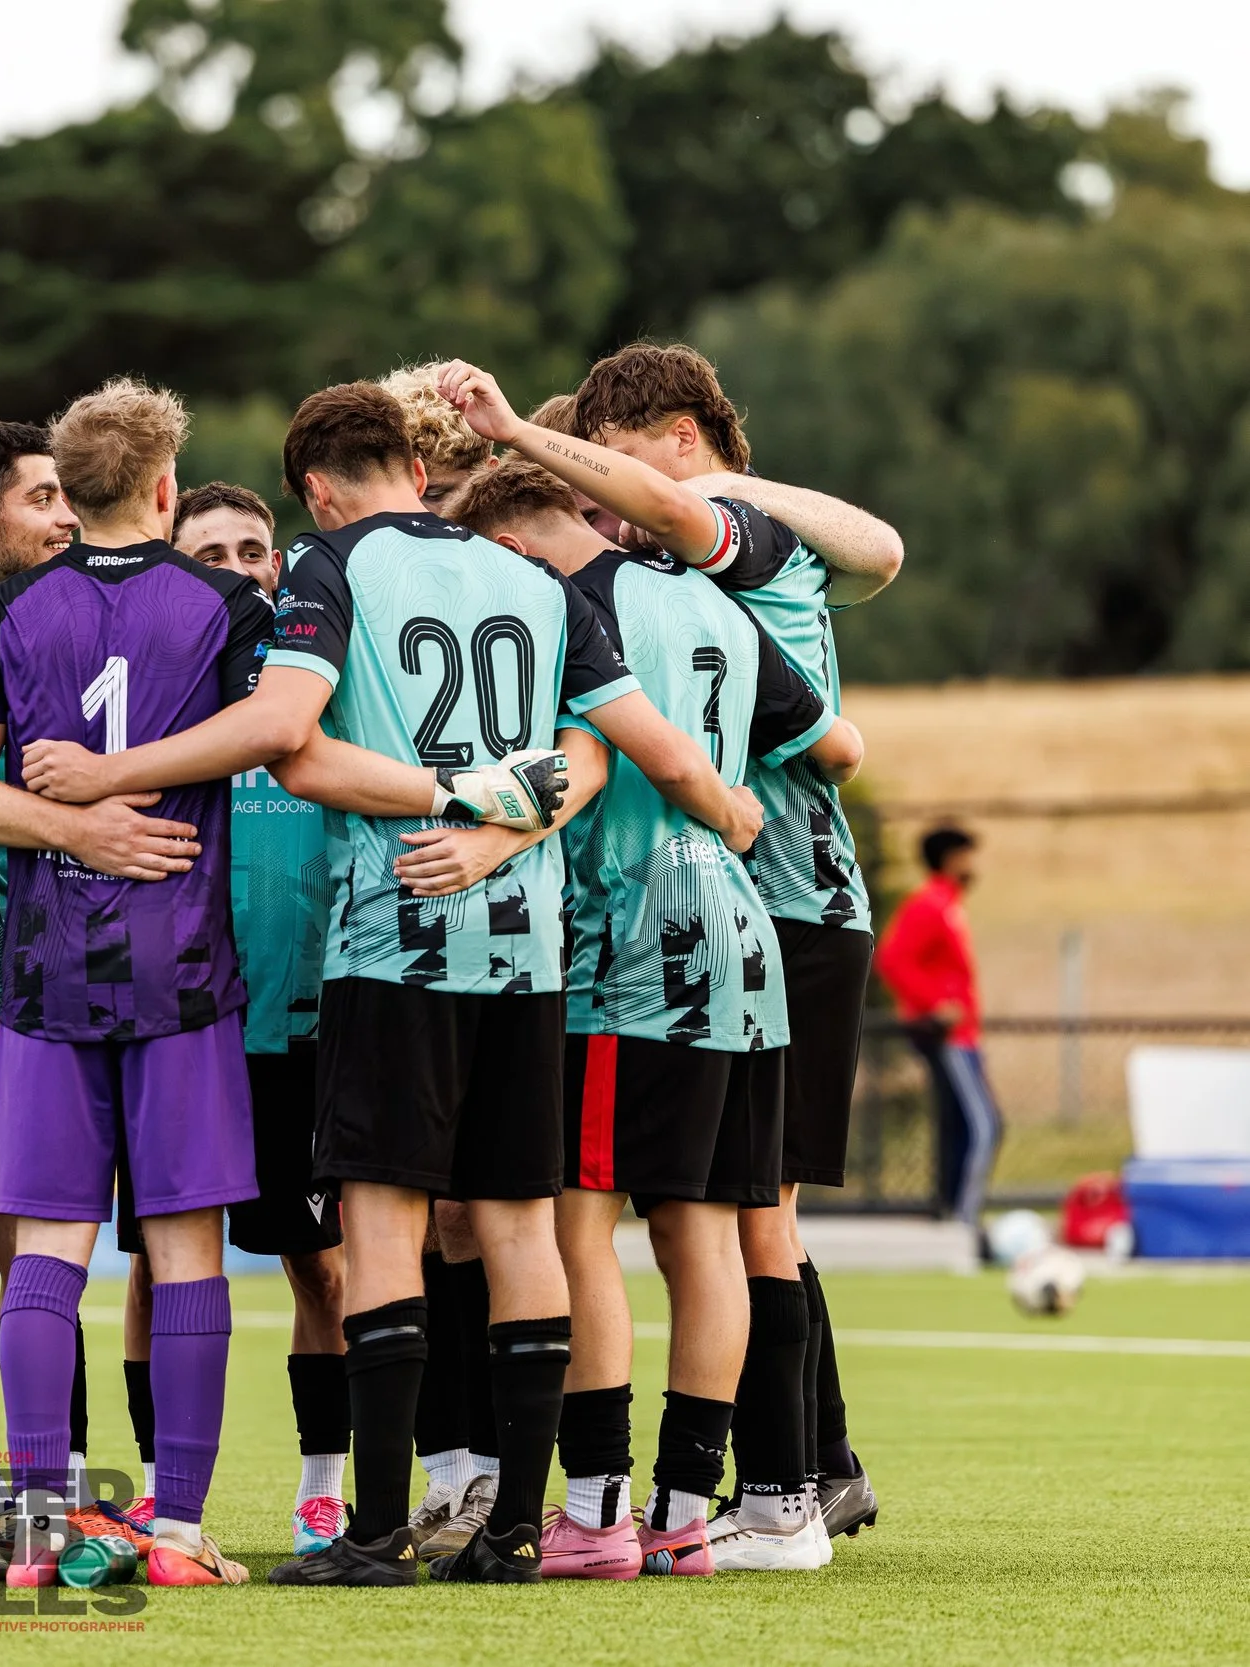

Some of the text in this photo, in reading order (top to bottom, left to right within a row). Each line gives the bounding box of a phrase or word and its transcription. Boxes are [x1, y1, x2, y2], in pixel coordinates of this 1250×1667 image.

[81, 656, 129, 755] 1
[398, 614, 536, 768] 20
[231, 800, 316, 814] AGE DOORS
[57, 869, 94, 881] CUSTOM
